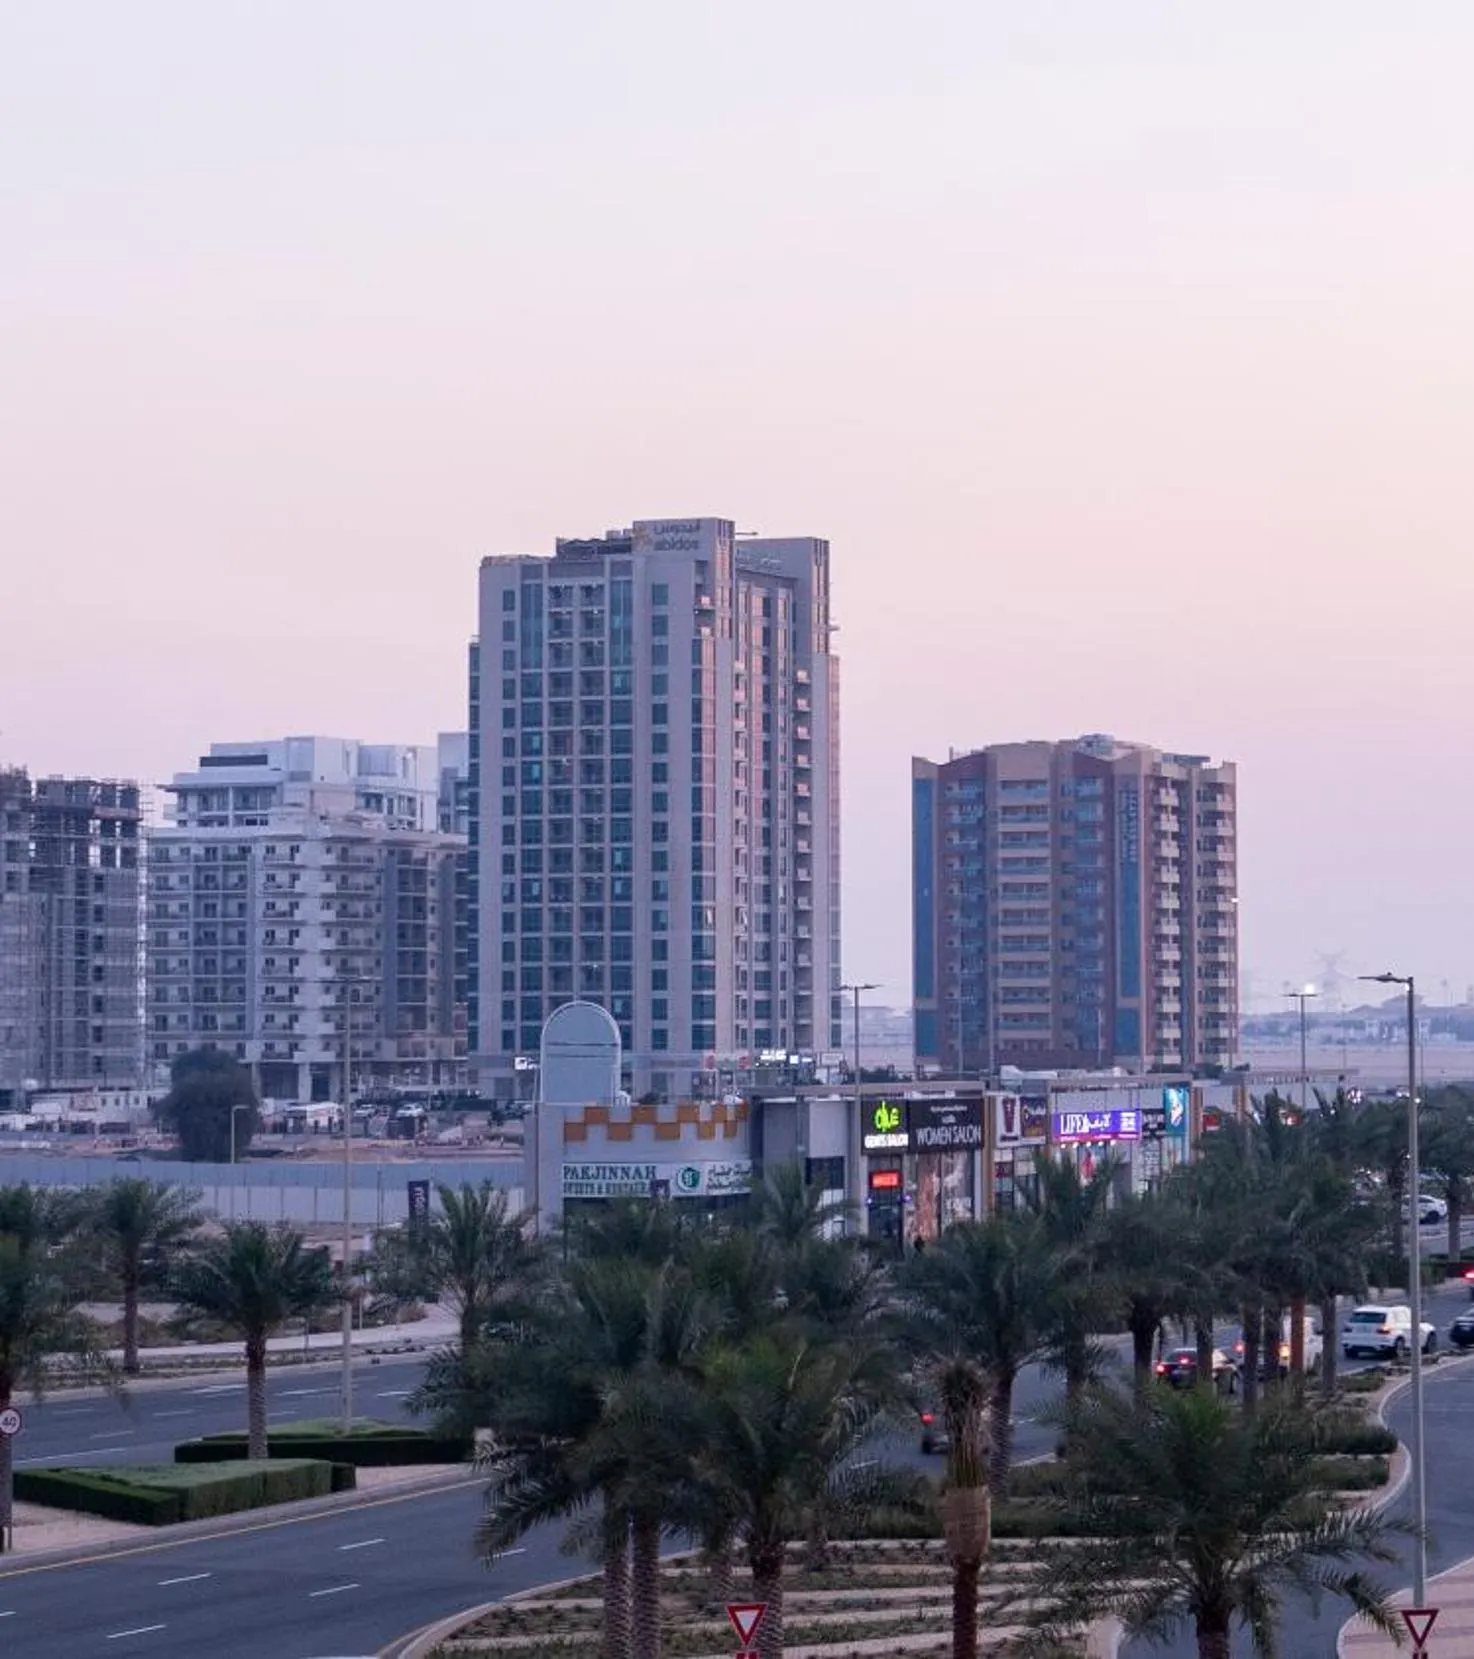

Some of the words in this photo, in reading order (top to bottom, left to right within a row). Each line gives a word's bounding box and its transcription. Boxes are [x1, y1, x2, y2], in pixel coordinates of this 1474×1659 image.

[654, 538, 699, 551] abidos
[915, 1127, 952, 1146] WOMEN
[952, 1124, 981, 1144] SALON
